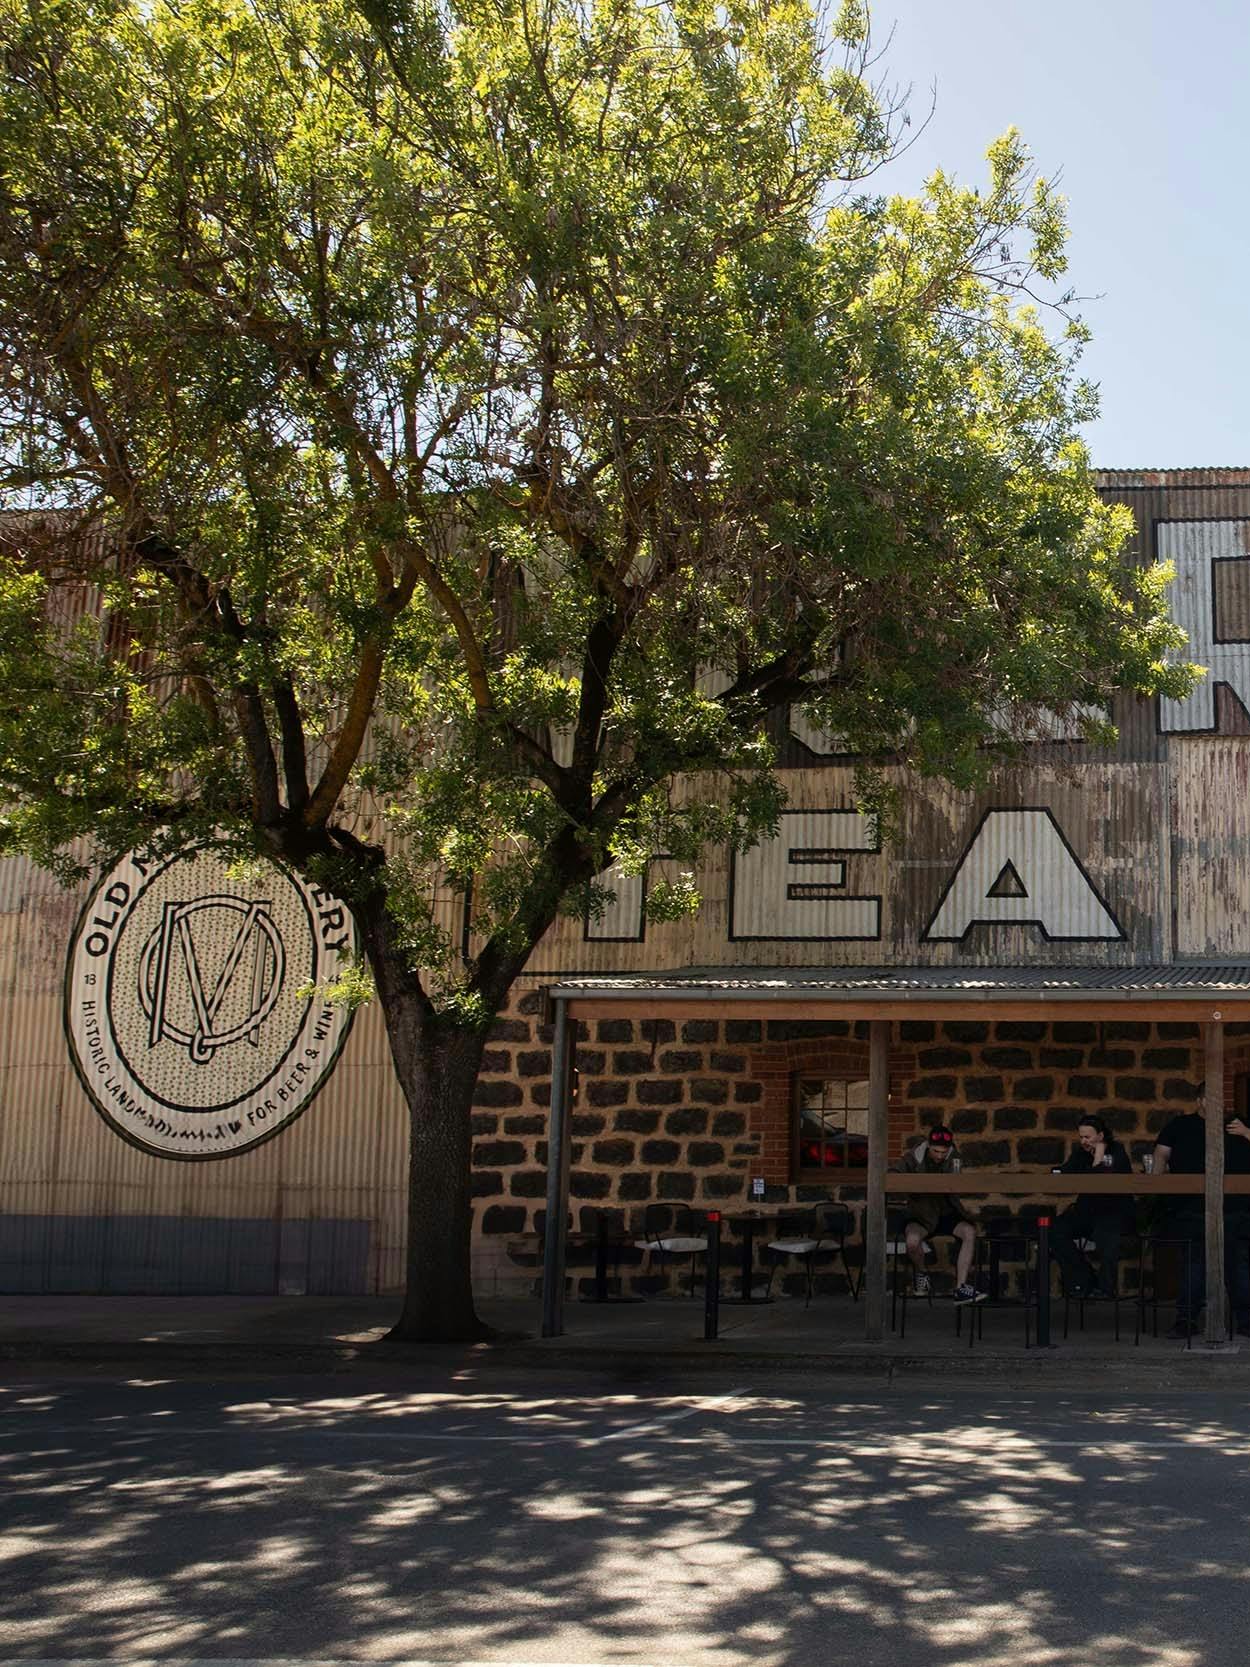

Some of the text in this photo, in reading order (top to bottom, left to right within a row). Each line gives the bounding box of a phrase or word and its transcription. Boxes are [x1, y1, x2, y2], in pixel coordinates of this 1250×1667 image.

[85, 881, 130, 957] OLD
[82, 1000, 110, 1074] HISTORIC
[247, 1100, 277, 1126] FOR
[277, 1062, 311, 1101] BEER
[304, 1048, 320, 1059] &
